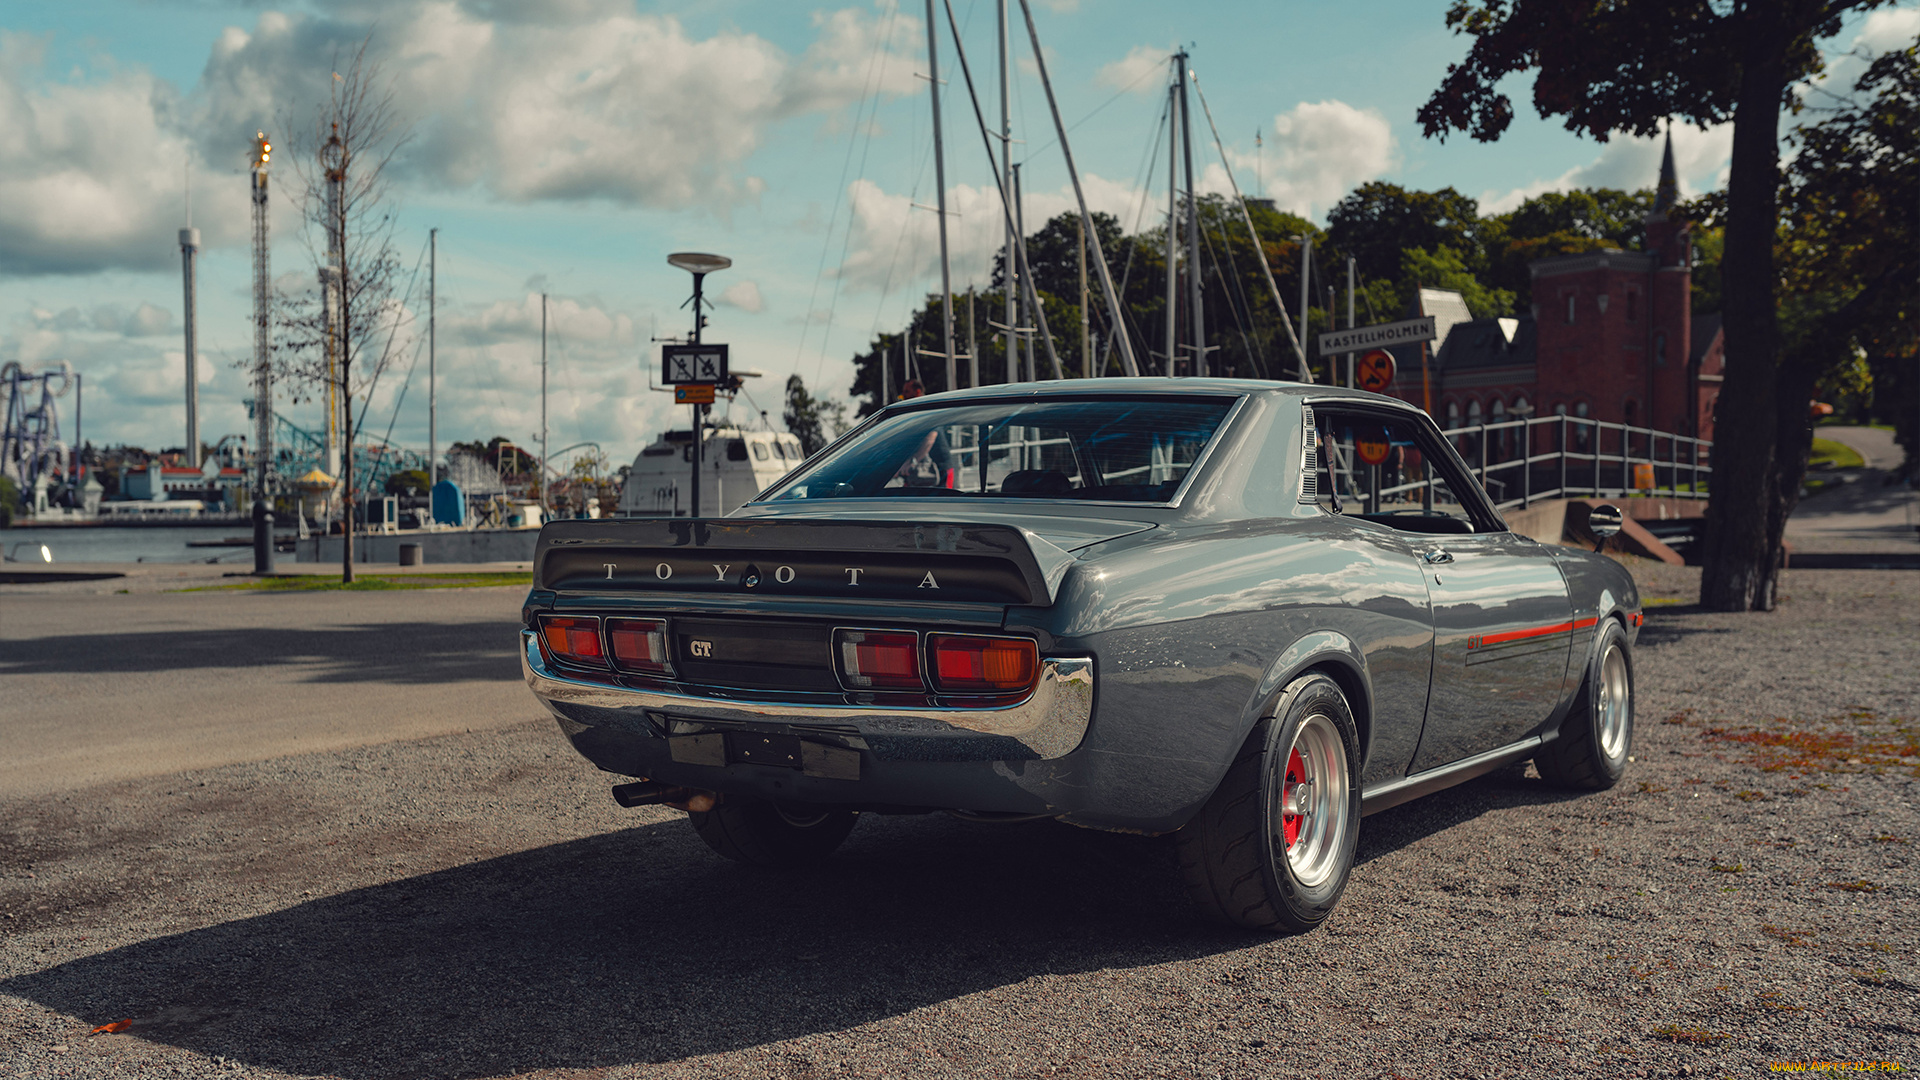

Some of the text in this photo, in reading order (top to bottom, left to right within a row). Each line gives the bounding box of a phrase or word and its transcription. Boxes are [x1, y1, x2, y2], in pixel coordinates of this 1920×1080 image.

[1325, 323, 1429, 349] KASTELLHOLMEN
[603, 563, 940, 589] TOYOTA
[690, 640, 712, 657] GT
[1467, 634, 1481, 649] GT
